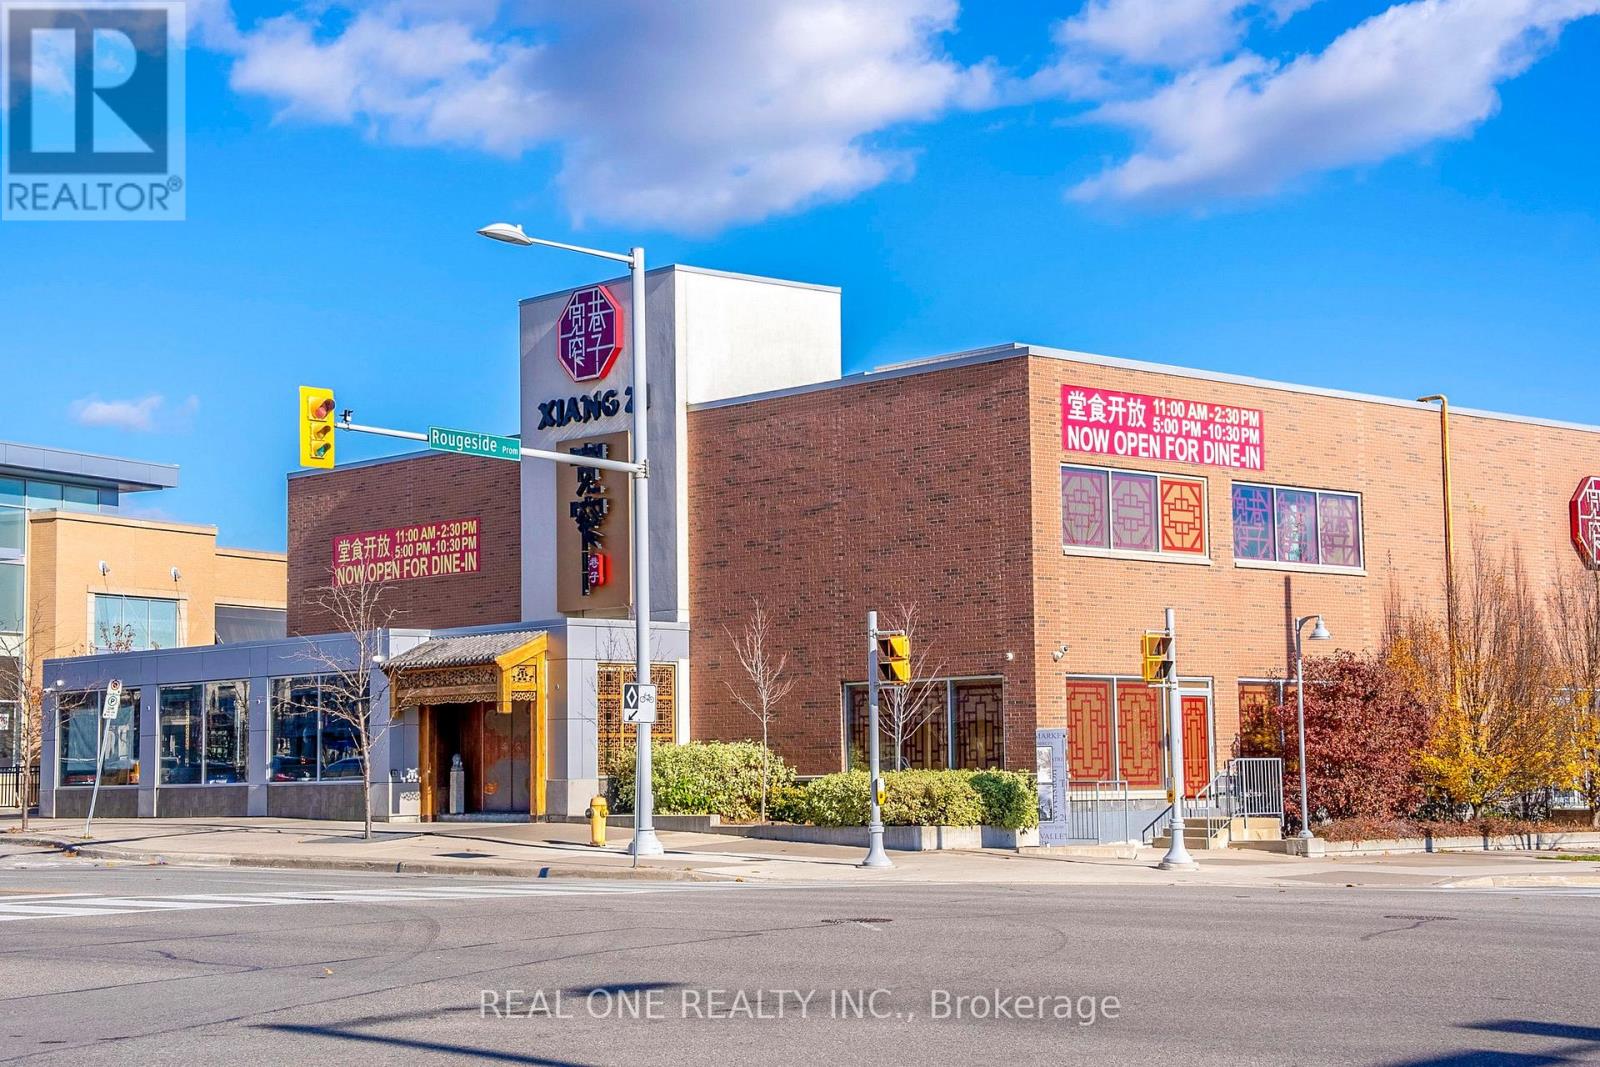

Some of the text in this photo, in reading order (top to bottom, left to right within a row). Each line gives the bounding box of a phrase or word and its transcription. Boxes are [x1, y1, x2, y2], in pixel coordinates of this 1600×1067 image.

[537, 389, 621, 430] XIANG
[1067, 390, 1146, 428] 堂食开放
[1153, 398, 1185, 417] 11:00
[1153, 417, 1179, 434] 5:00
[432, 429, 518, 455] Rougeside Prom
[1067, 425, 1261, 470] NOW OPEN FOR DINE-IN
[338, 534, 390, 562] 堂食开放
[395, 528, 418, 543] 11:00
[395, 543, 413, 558] 5:00
[336, 551, 477, 586] NOW OPEN FOR DINE-IN
